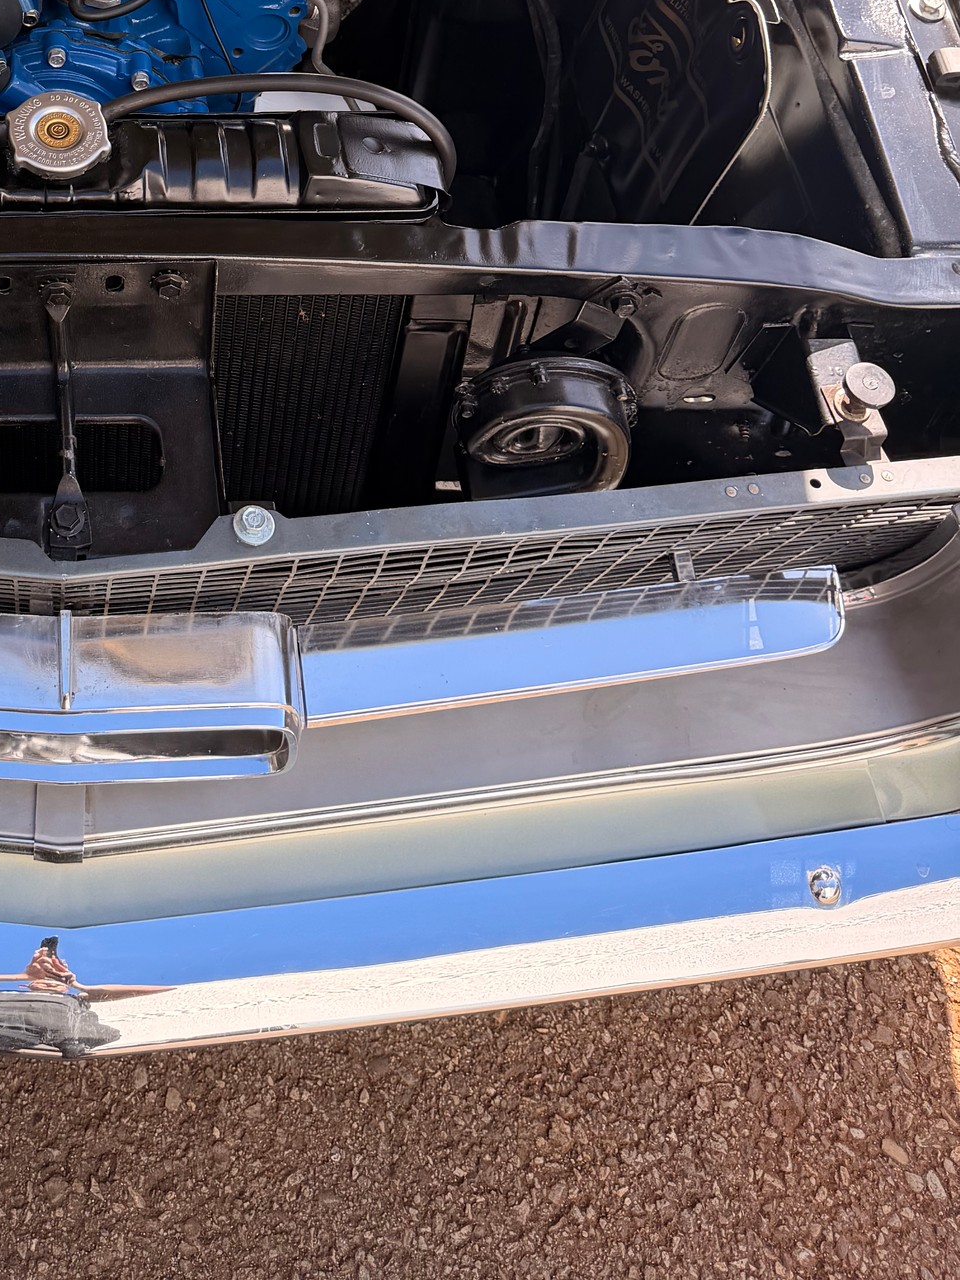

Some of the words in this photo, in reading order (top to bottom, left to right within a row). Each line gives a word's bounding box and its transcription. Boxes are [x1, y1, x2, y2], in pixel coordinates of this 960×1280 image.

[13, 98, 42, 141] WARNING
[27, 141, 47, 157] REFER
[48, 152, 58, 160] TO
